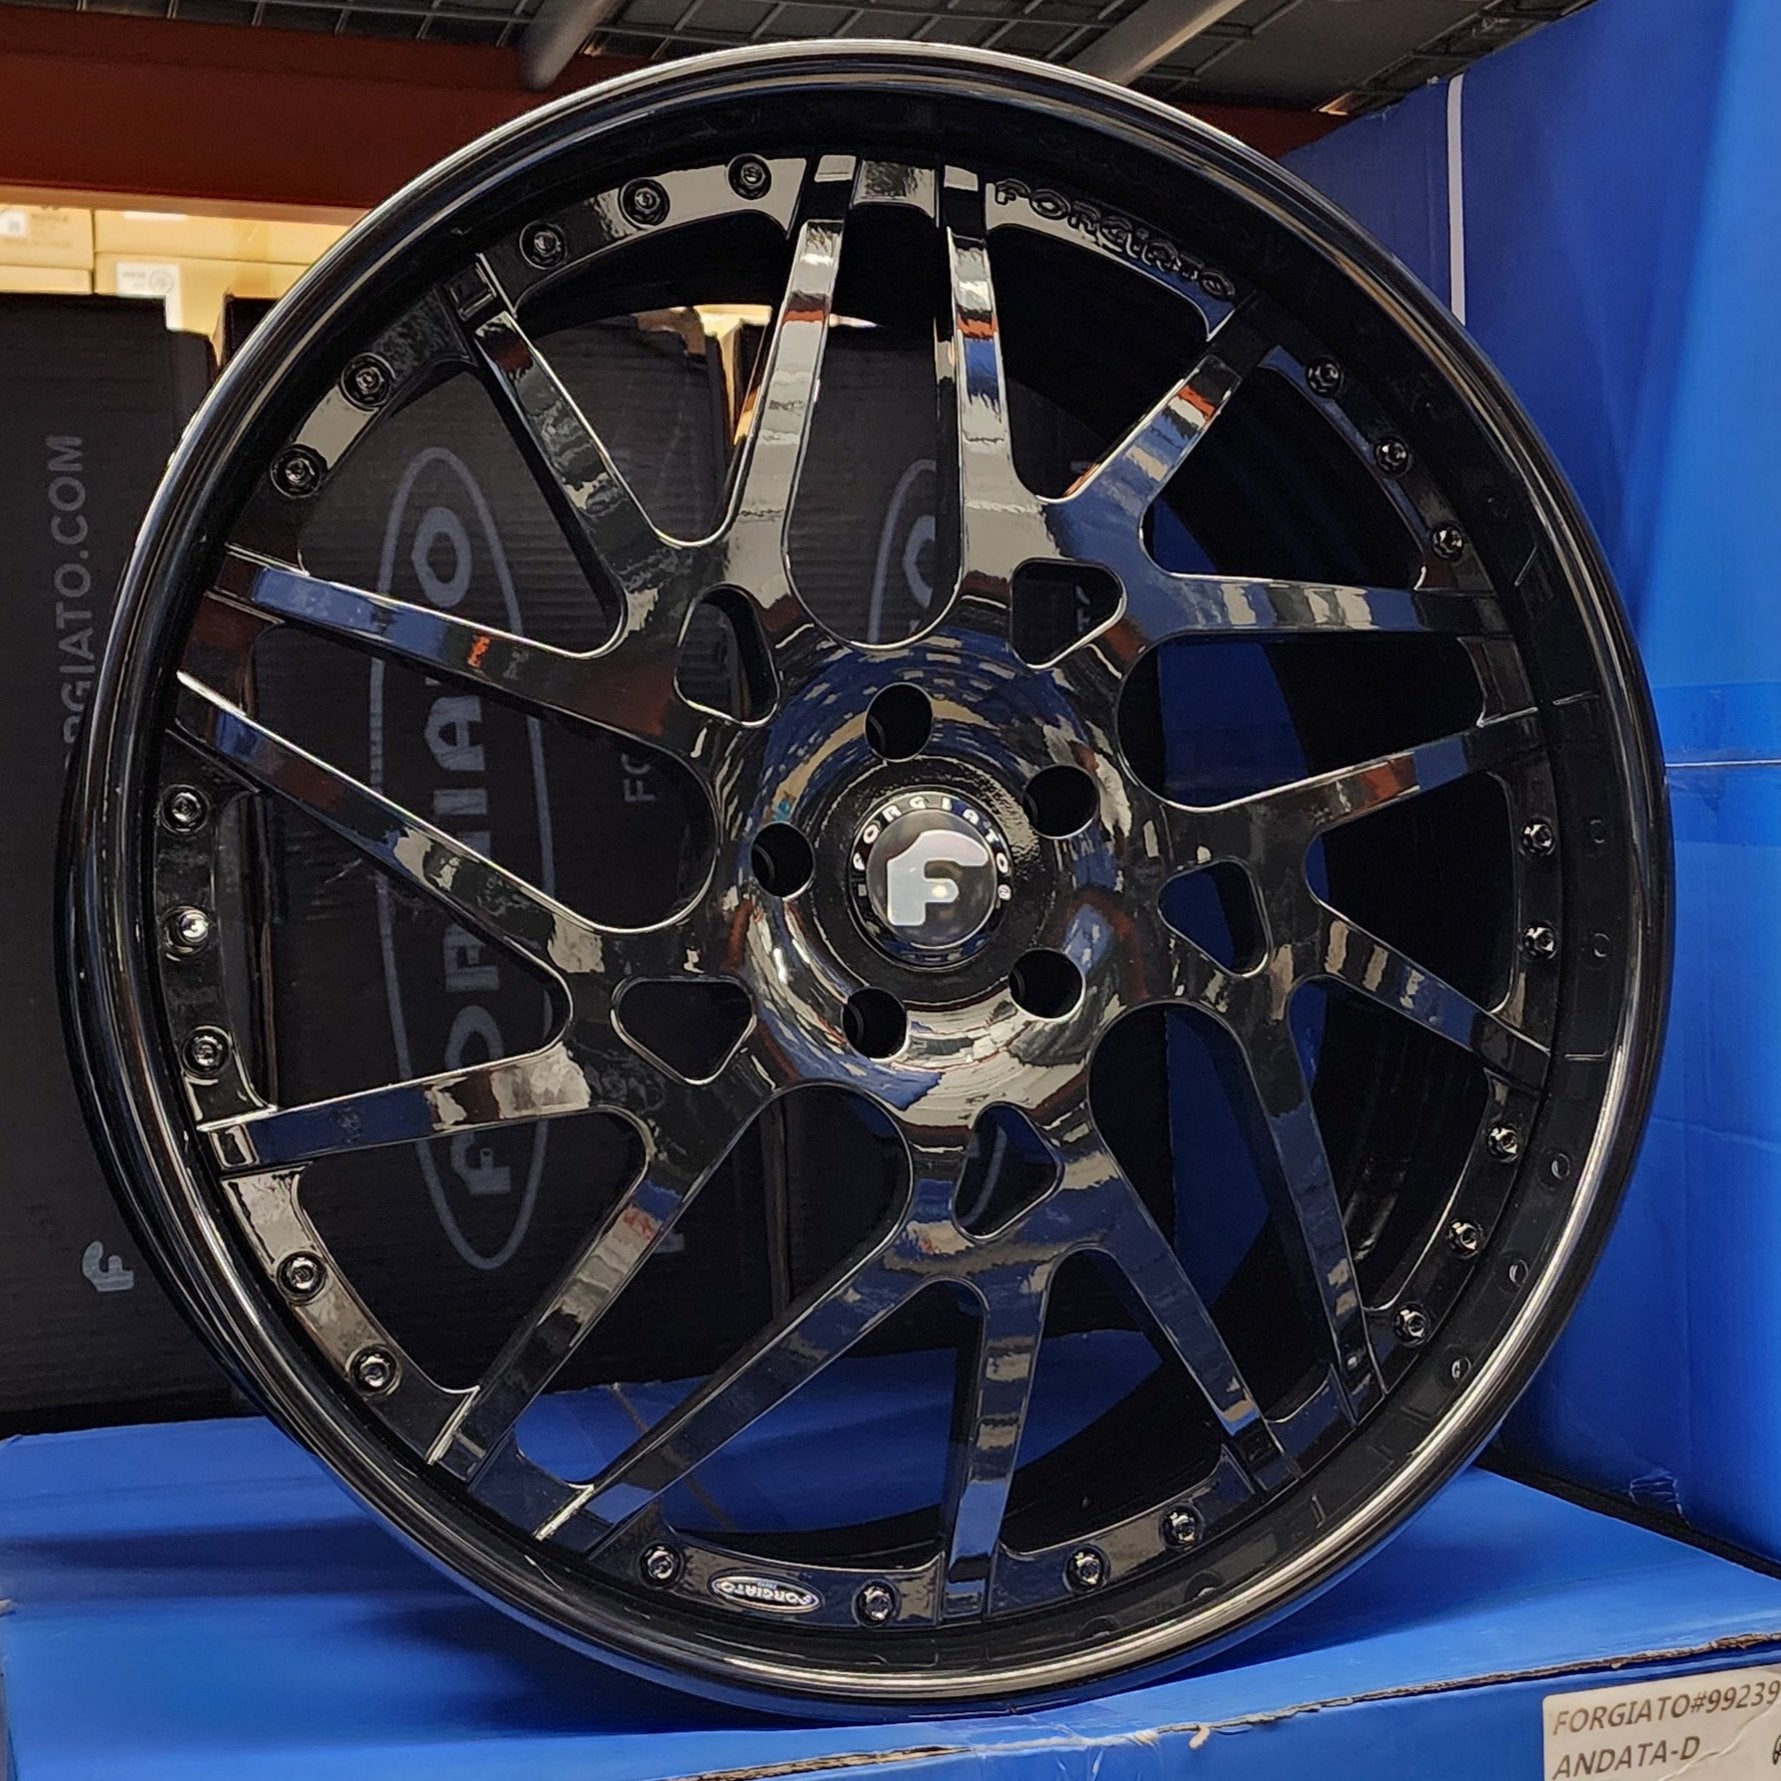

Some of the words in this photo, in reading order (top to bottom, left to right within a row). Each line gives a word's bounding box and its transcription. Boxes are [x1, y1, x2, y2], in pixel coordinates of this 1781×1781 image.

[46, 435, 97, 769] GIATO.COM
[412, 506, 511, 1195] FORIAO
[1551, 1735, 1700, 1781] ANDATA-D
